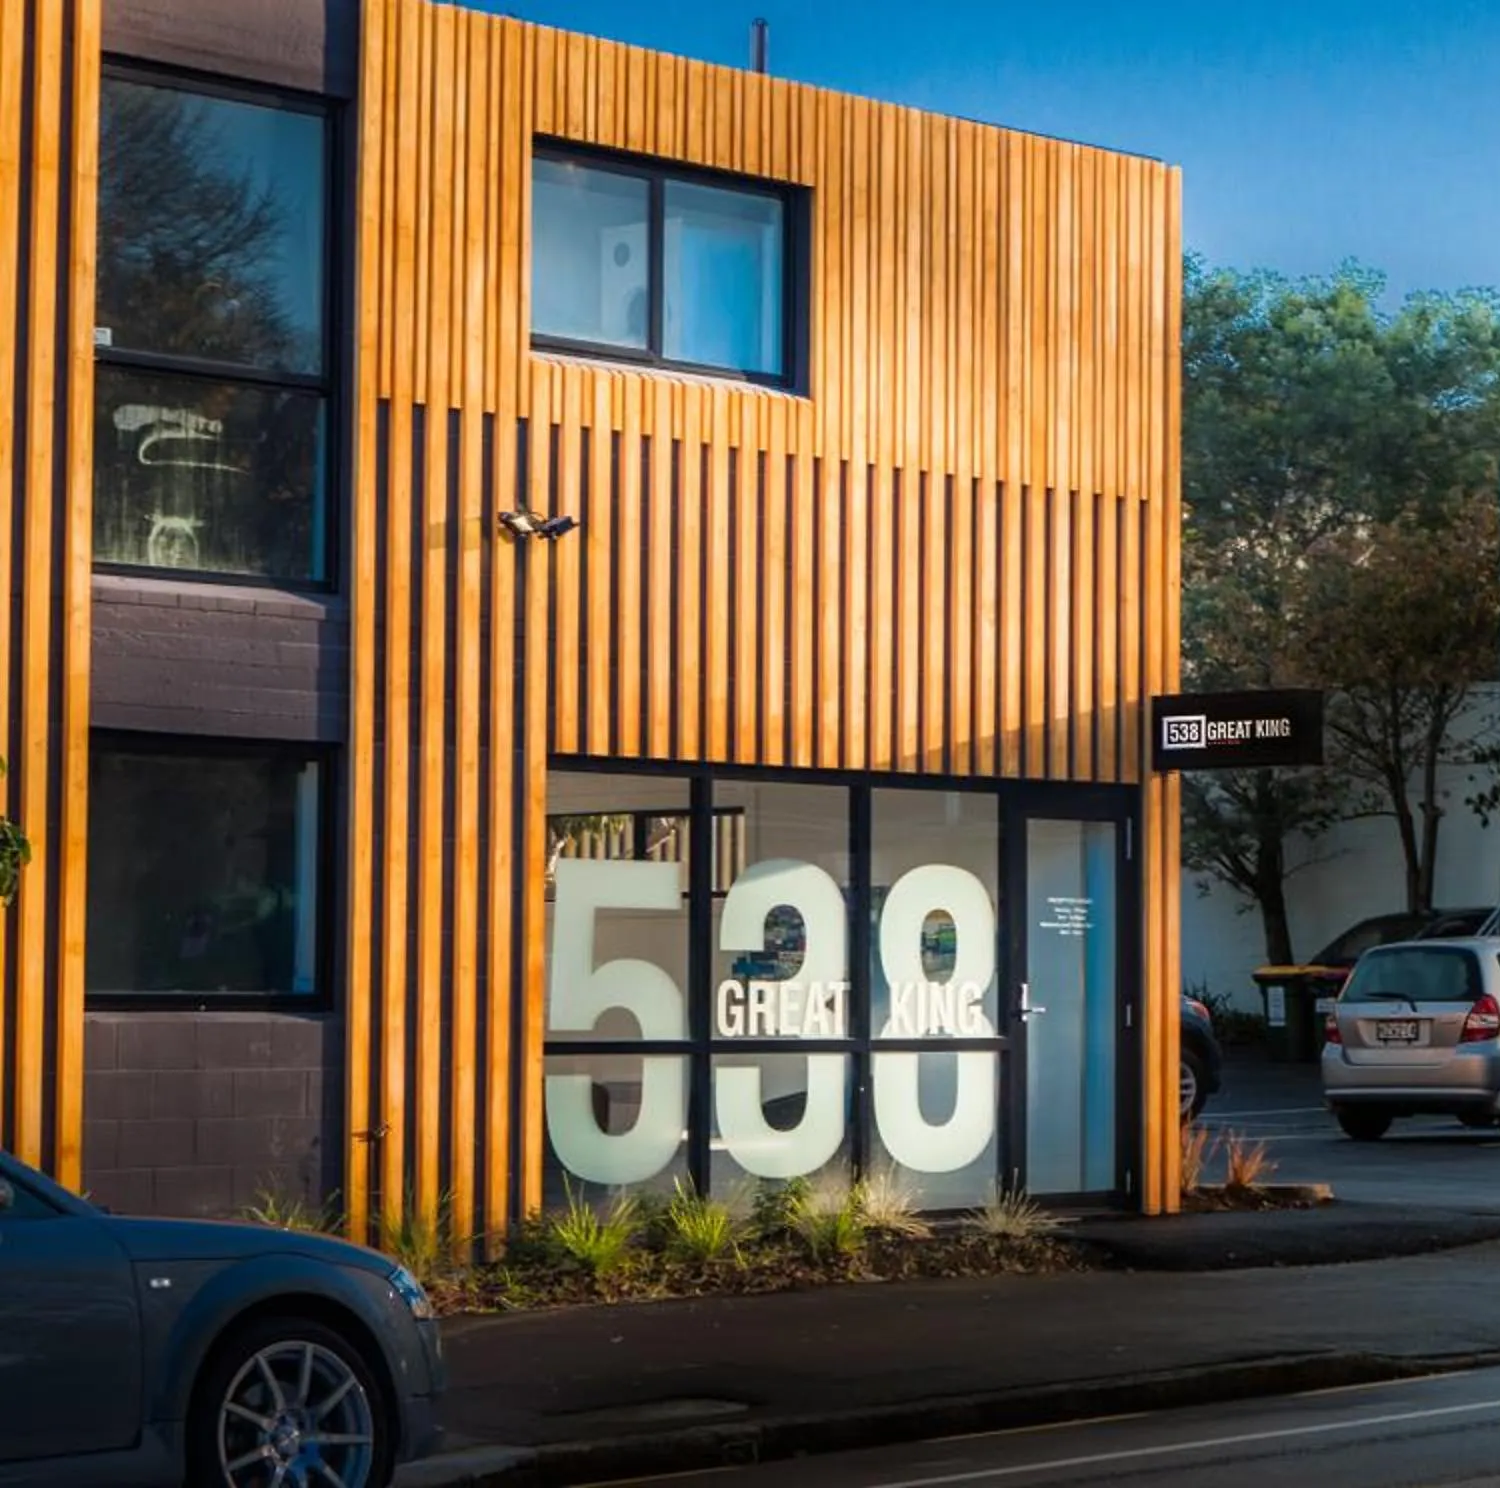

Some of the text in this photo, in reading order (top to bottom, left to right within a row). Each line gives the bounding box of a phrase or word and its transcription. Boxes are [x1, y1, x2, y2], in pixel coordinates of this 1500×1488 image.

[1169, 718, 1292, 742] 538 GREAT KING
[545, 858, 996, 1185] 538
[717, 979, 984, 1037] GREAT KING
